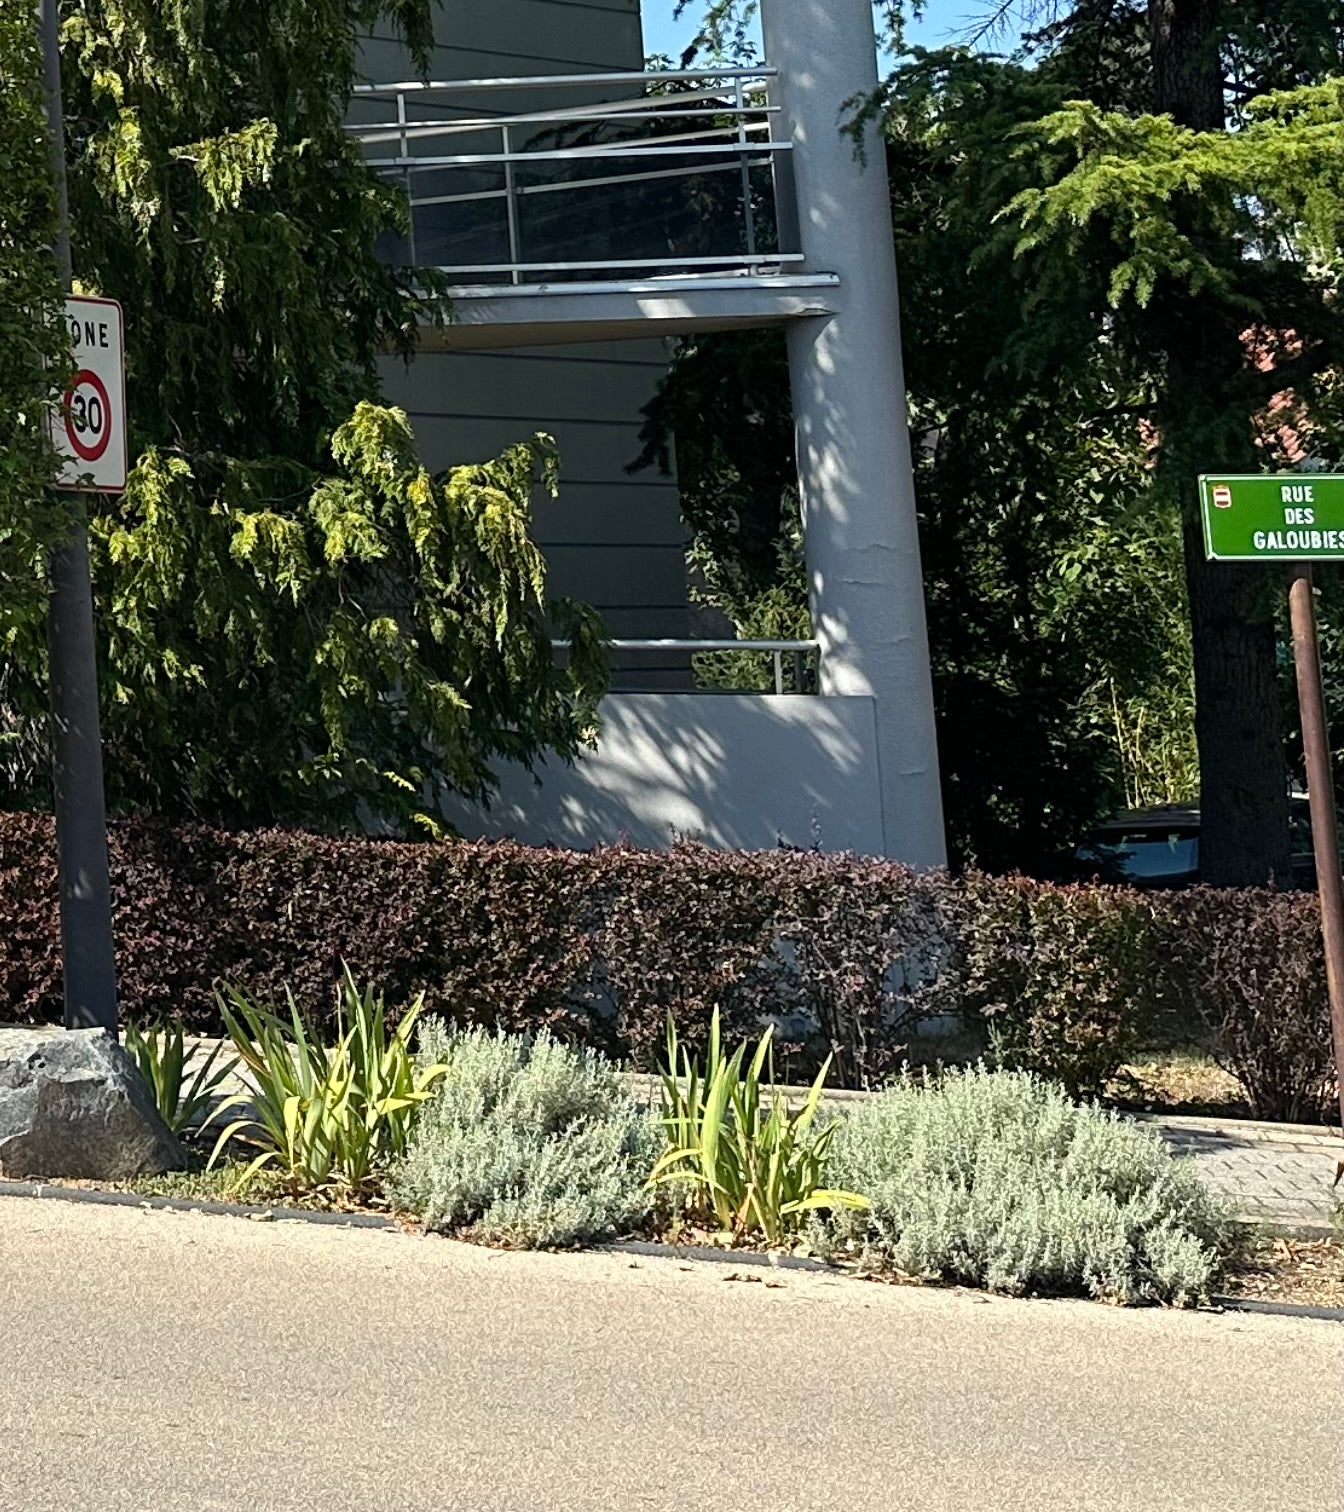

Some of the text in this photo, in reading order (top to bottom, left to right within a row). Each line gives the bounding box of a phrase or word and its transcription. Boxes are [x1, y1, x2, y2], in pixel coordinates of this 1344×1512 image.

[69, 320, 109, 348] ONE
[73, 394, 103, 434] 30
[1281, 485, 1315, 503] RUE
[1284, 507, 1315, 525] DES
